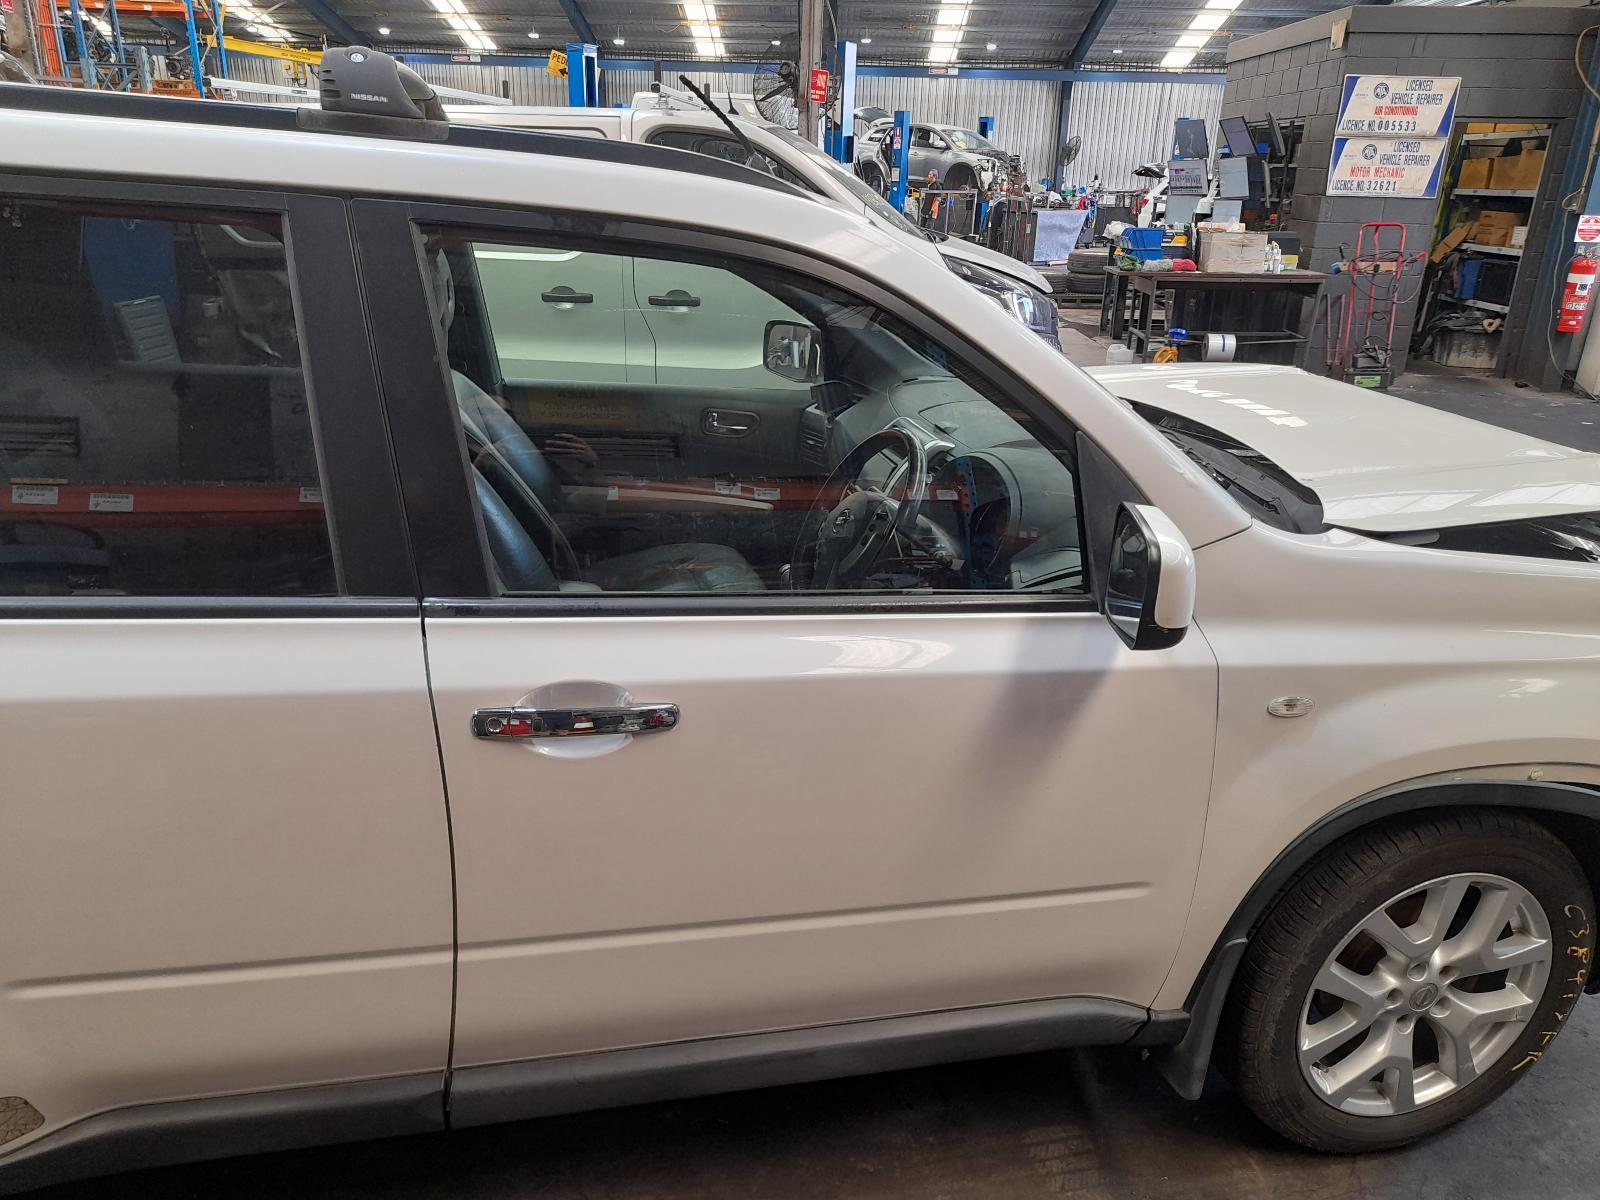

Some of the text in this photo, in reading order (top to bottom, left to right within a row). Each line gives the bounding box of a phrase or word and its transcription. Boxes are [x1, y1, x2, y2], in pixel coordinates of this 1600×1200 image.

[552, 52, 568, 65] PED
[1405, 79, 1434, 92] LICENSED
[350, 93, 389, 103] NISSAN
[1390, 92, 1444, 106] VEHICLE REPAIRER
[1374, 105, 1419, 116] AIR CONDITIONING
[1341, 119, 1366, 131] LICENCE
[1377, 120, 1418, 132] 005533
[1393, 141, 1421, 153] LICENSED
[1379, 154, 1431, 167] VEHICLE REPAIRER
[1349, 166, 1406, 179] MOTOR MECHANIC
[1331, 180, 1354, 191] LICENCE
[1366, 180, 1397, 192] 32621
